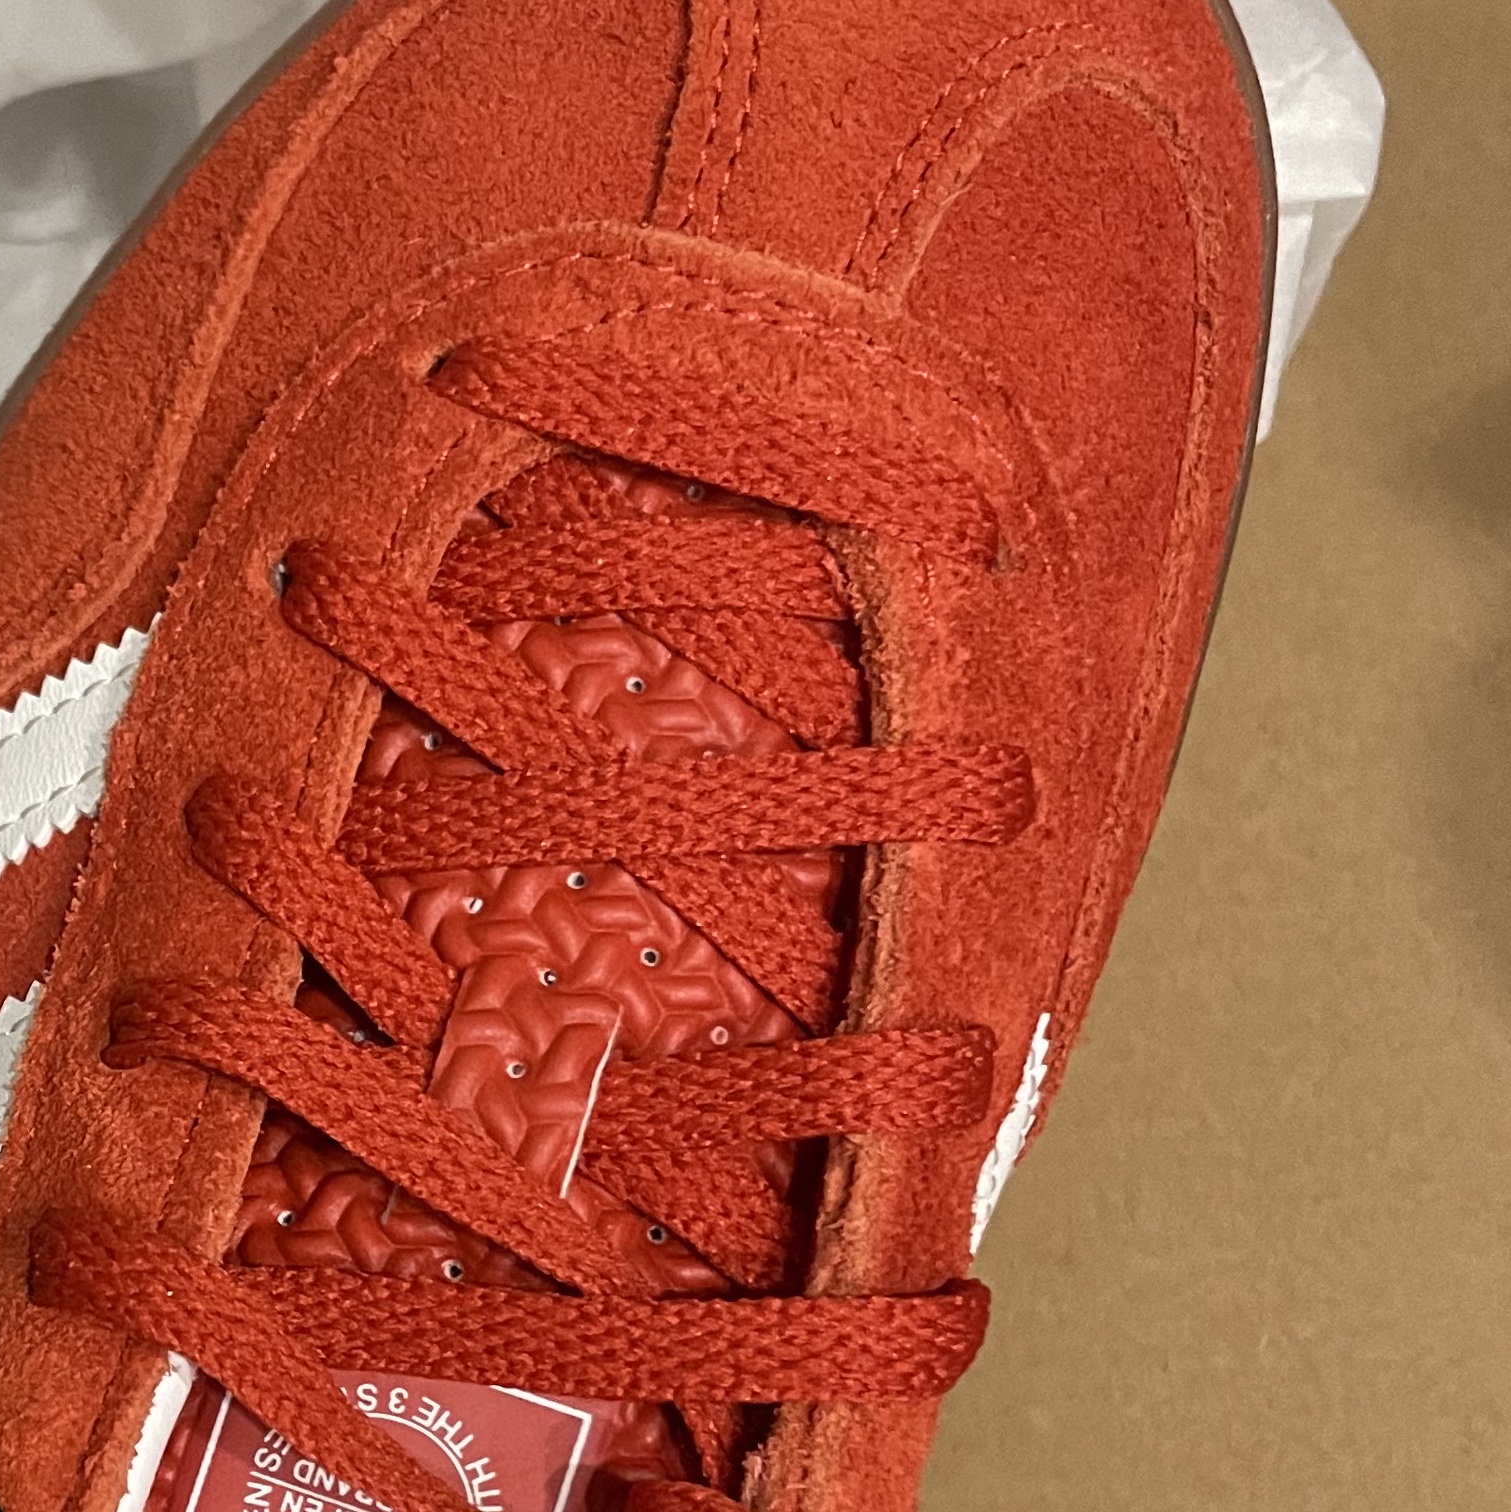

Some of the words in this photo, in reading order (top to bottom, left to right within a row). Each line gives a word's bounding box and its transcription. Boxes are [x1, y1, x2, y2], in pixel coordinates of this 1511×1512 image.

[389, 1386, 410, 1412] 3
[413, 1396, 474, 1459] THE
[465, 1457, 503, 1512] ITH
